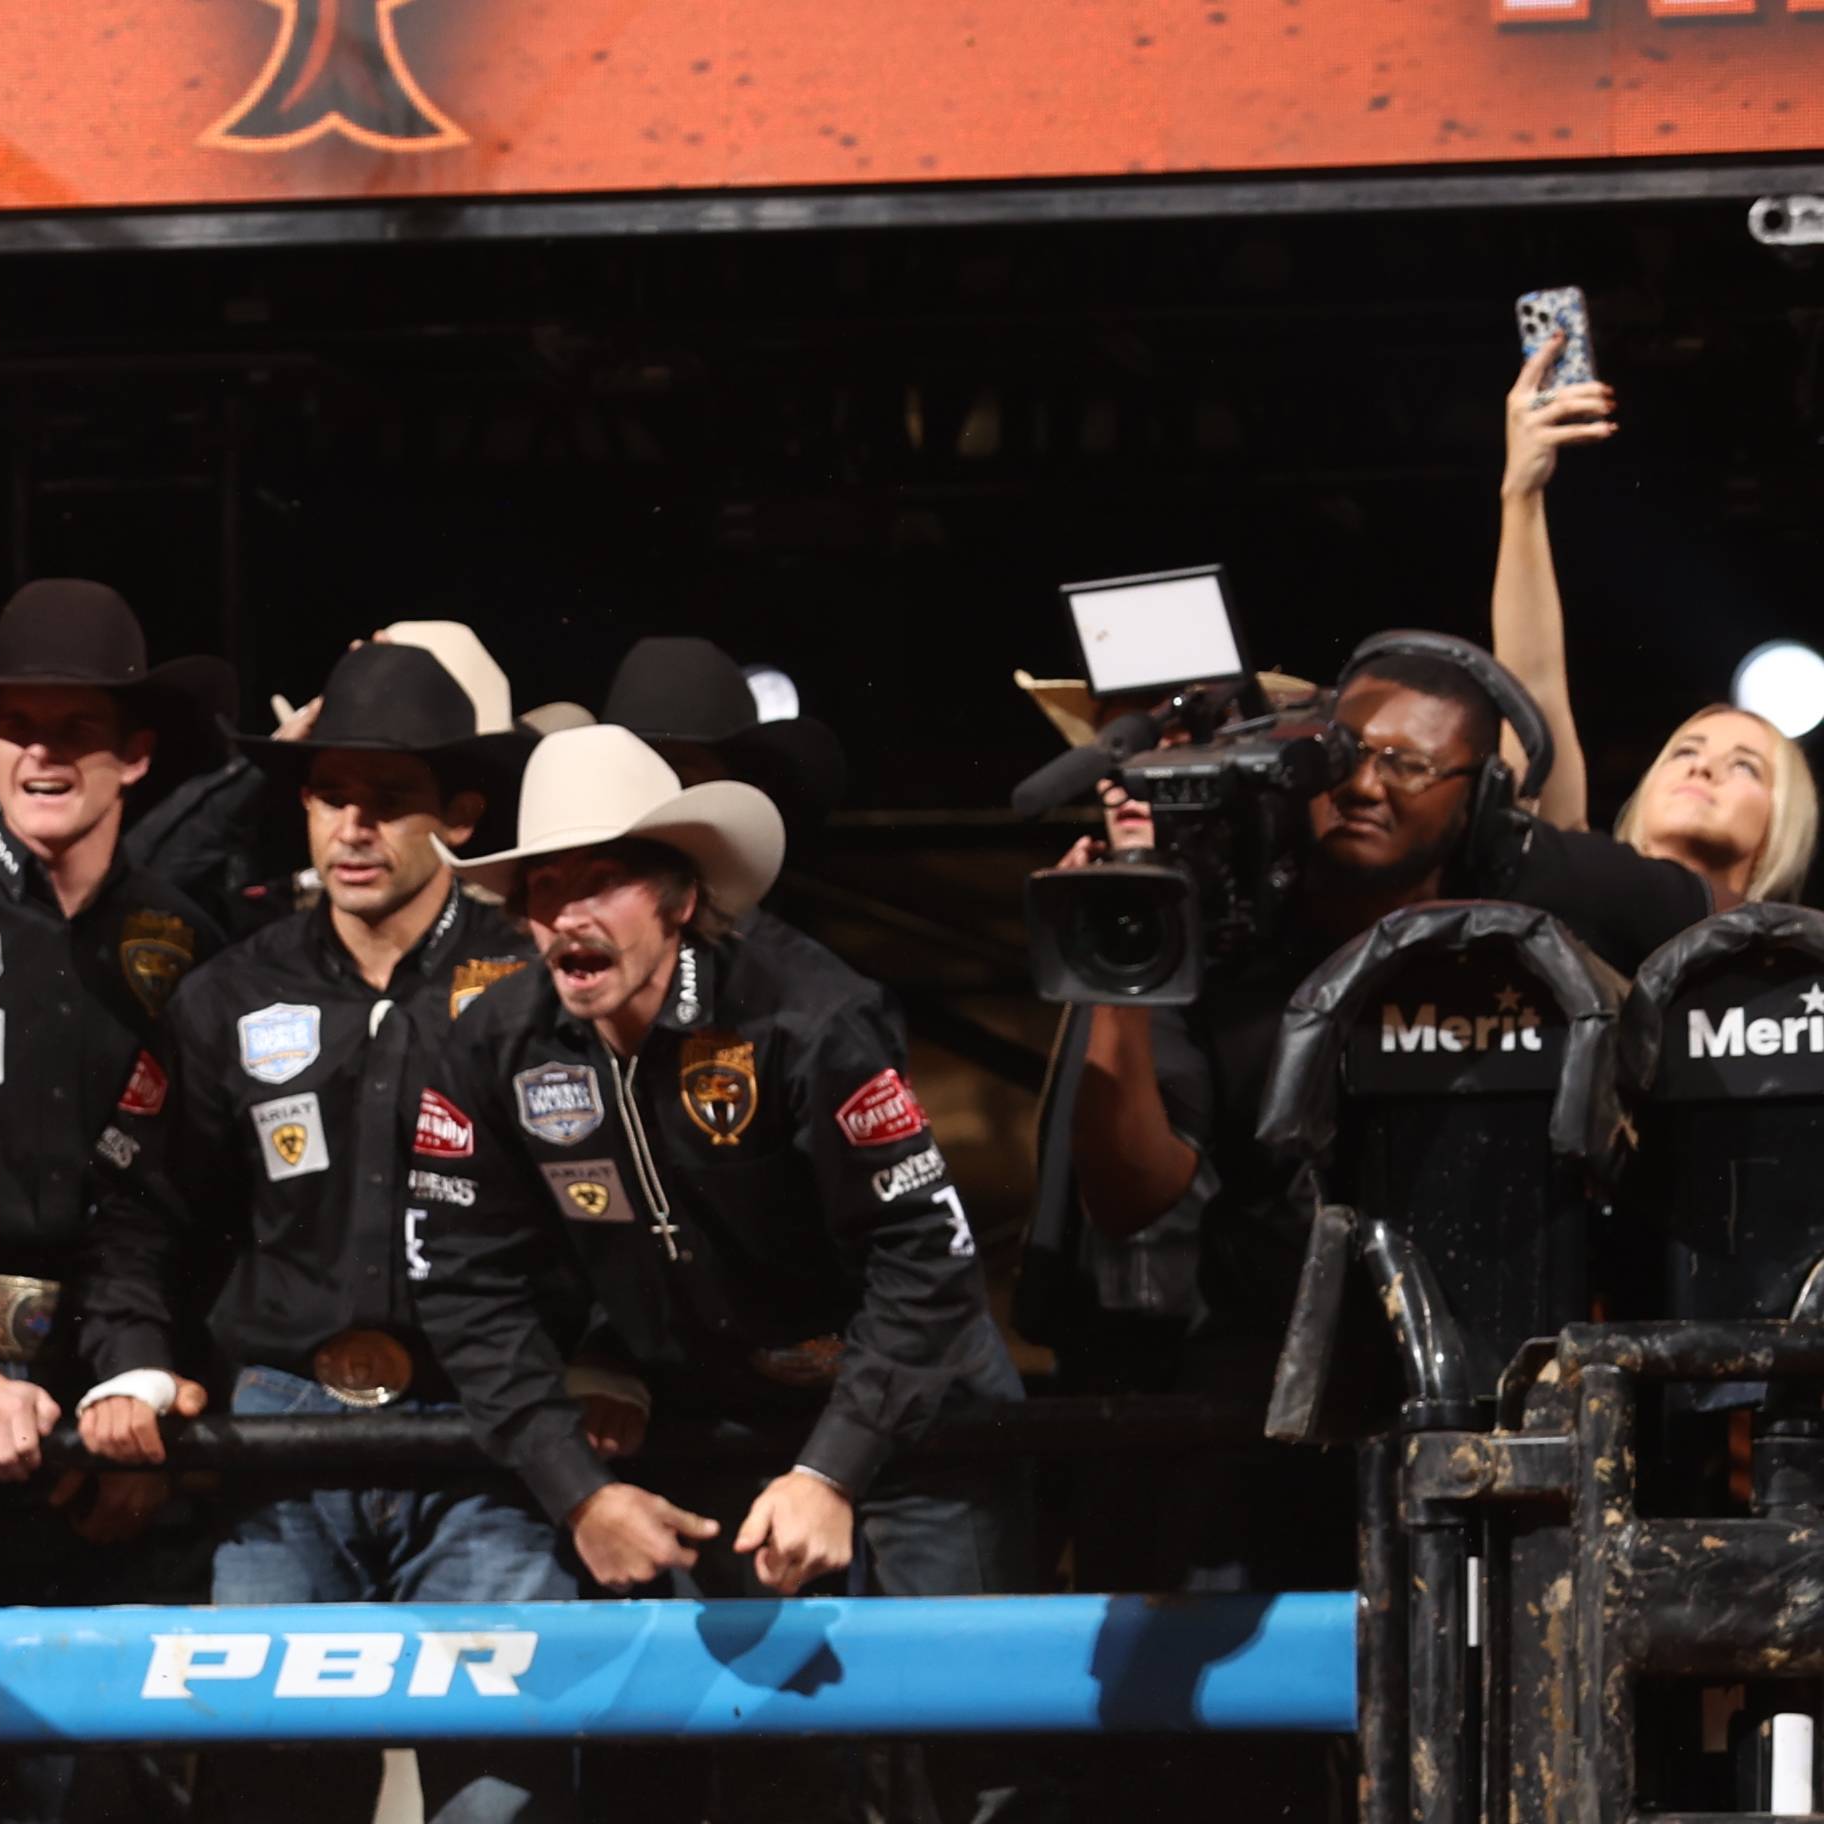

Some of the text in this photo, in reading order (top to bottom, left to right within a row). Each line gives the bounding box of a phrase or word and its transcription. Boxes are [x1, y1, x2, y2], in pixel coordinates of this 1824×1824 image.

[1381, 985, 1543, 1053] Merit
[1688, 983, 1824, 1059] Meri
[258, 1101, 313, 1126] ARIAT
[141, 1631, 539, 1699] PBR
